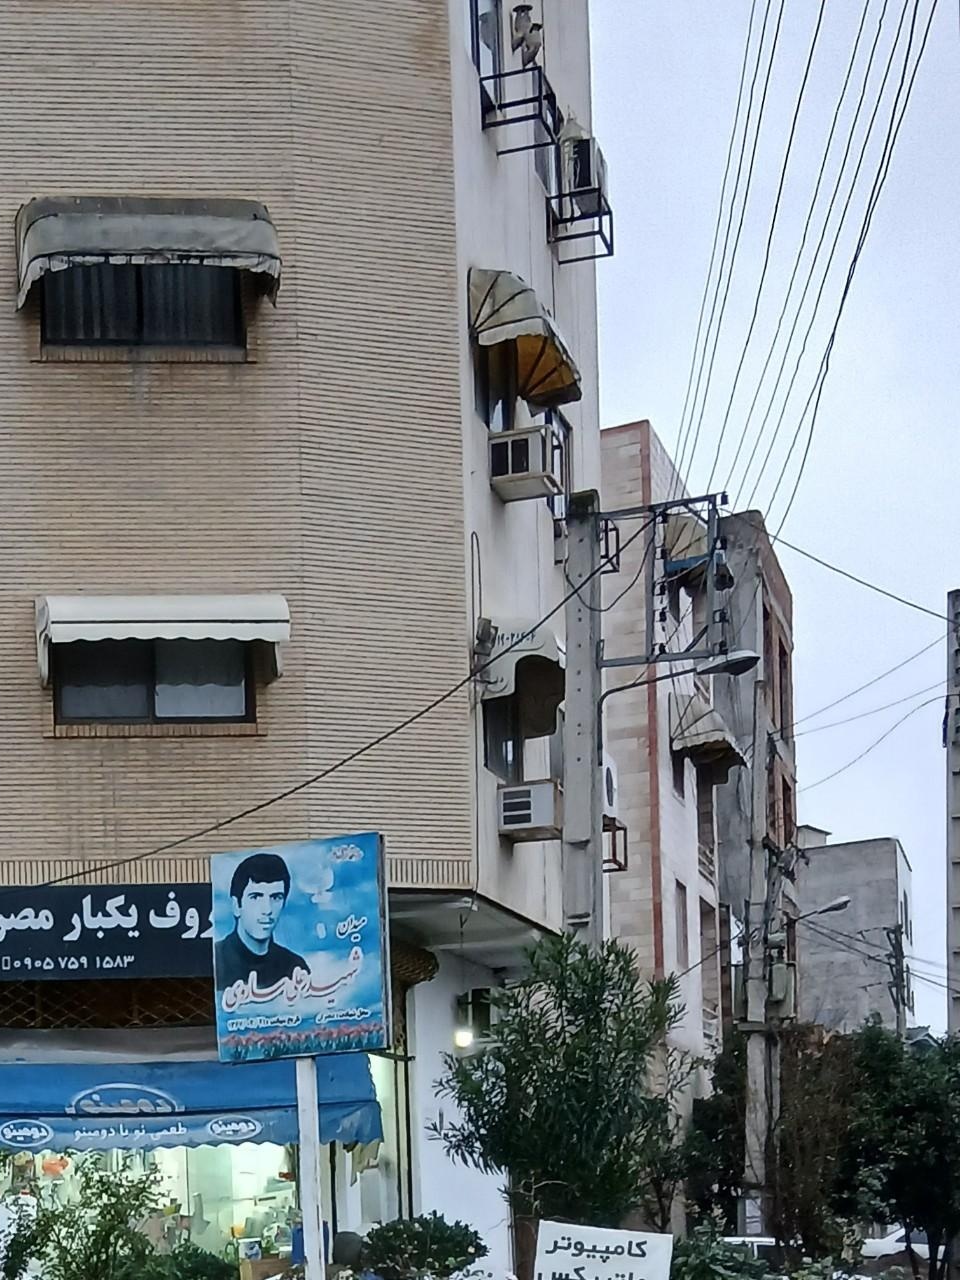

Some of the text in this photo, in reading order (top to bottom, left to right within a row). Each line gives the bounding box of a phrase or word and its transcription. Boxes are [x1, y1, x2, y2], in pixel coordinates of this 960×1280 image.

[62, 893, 141, 942] یکبار
[149, 890, 214, 939] روف
[336, 914, 367, 942] میدان
[2, 1123, 49, 1141] دومینو
[73, 1126, 117, 1142] دومینو
[149, 1121, 188, 1141] طعمی
[211, 1120, 257, 1136] دومینو
[545, 1236, 648, 1263] کامپیوتر
